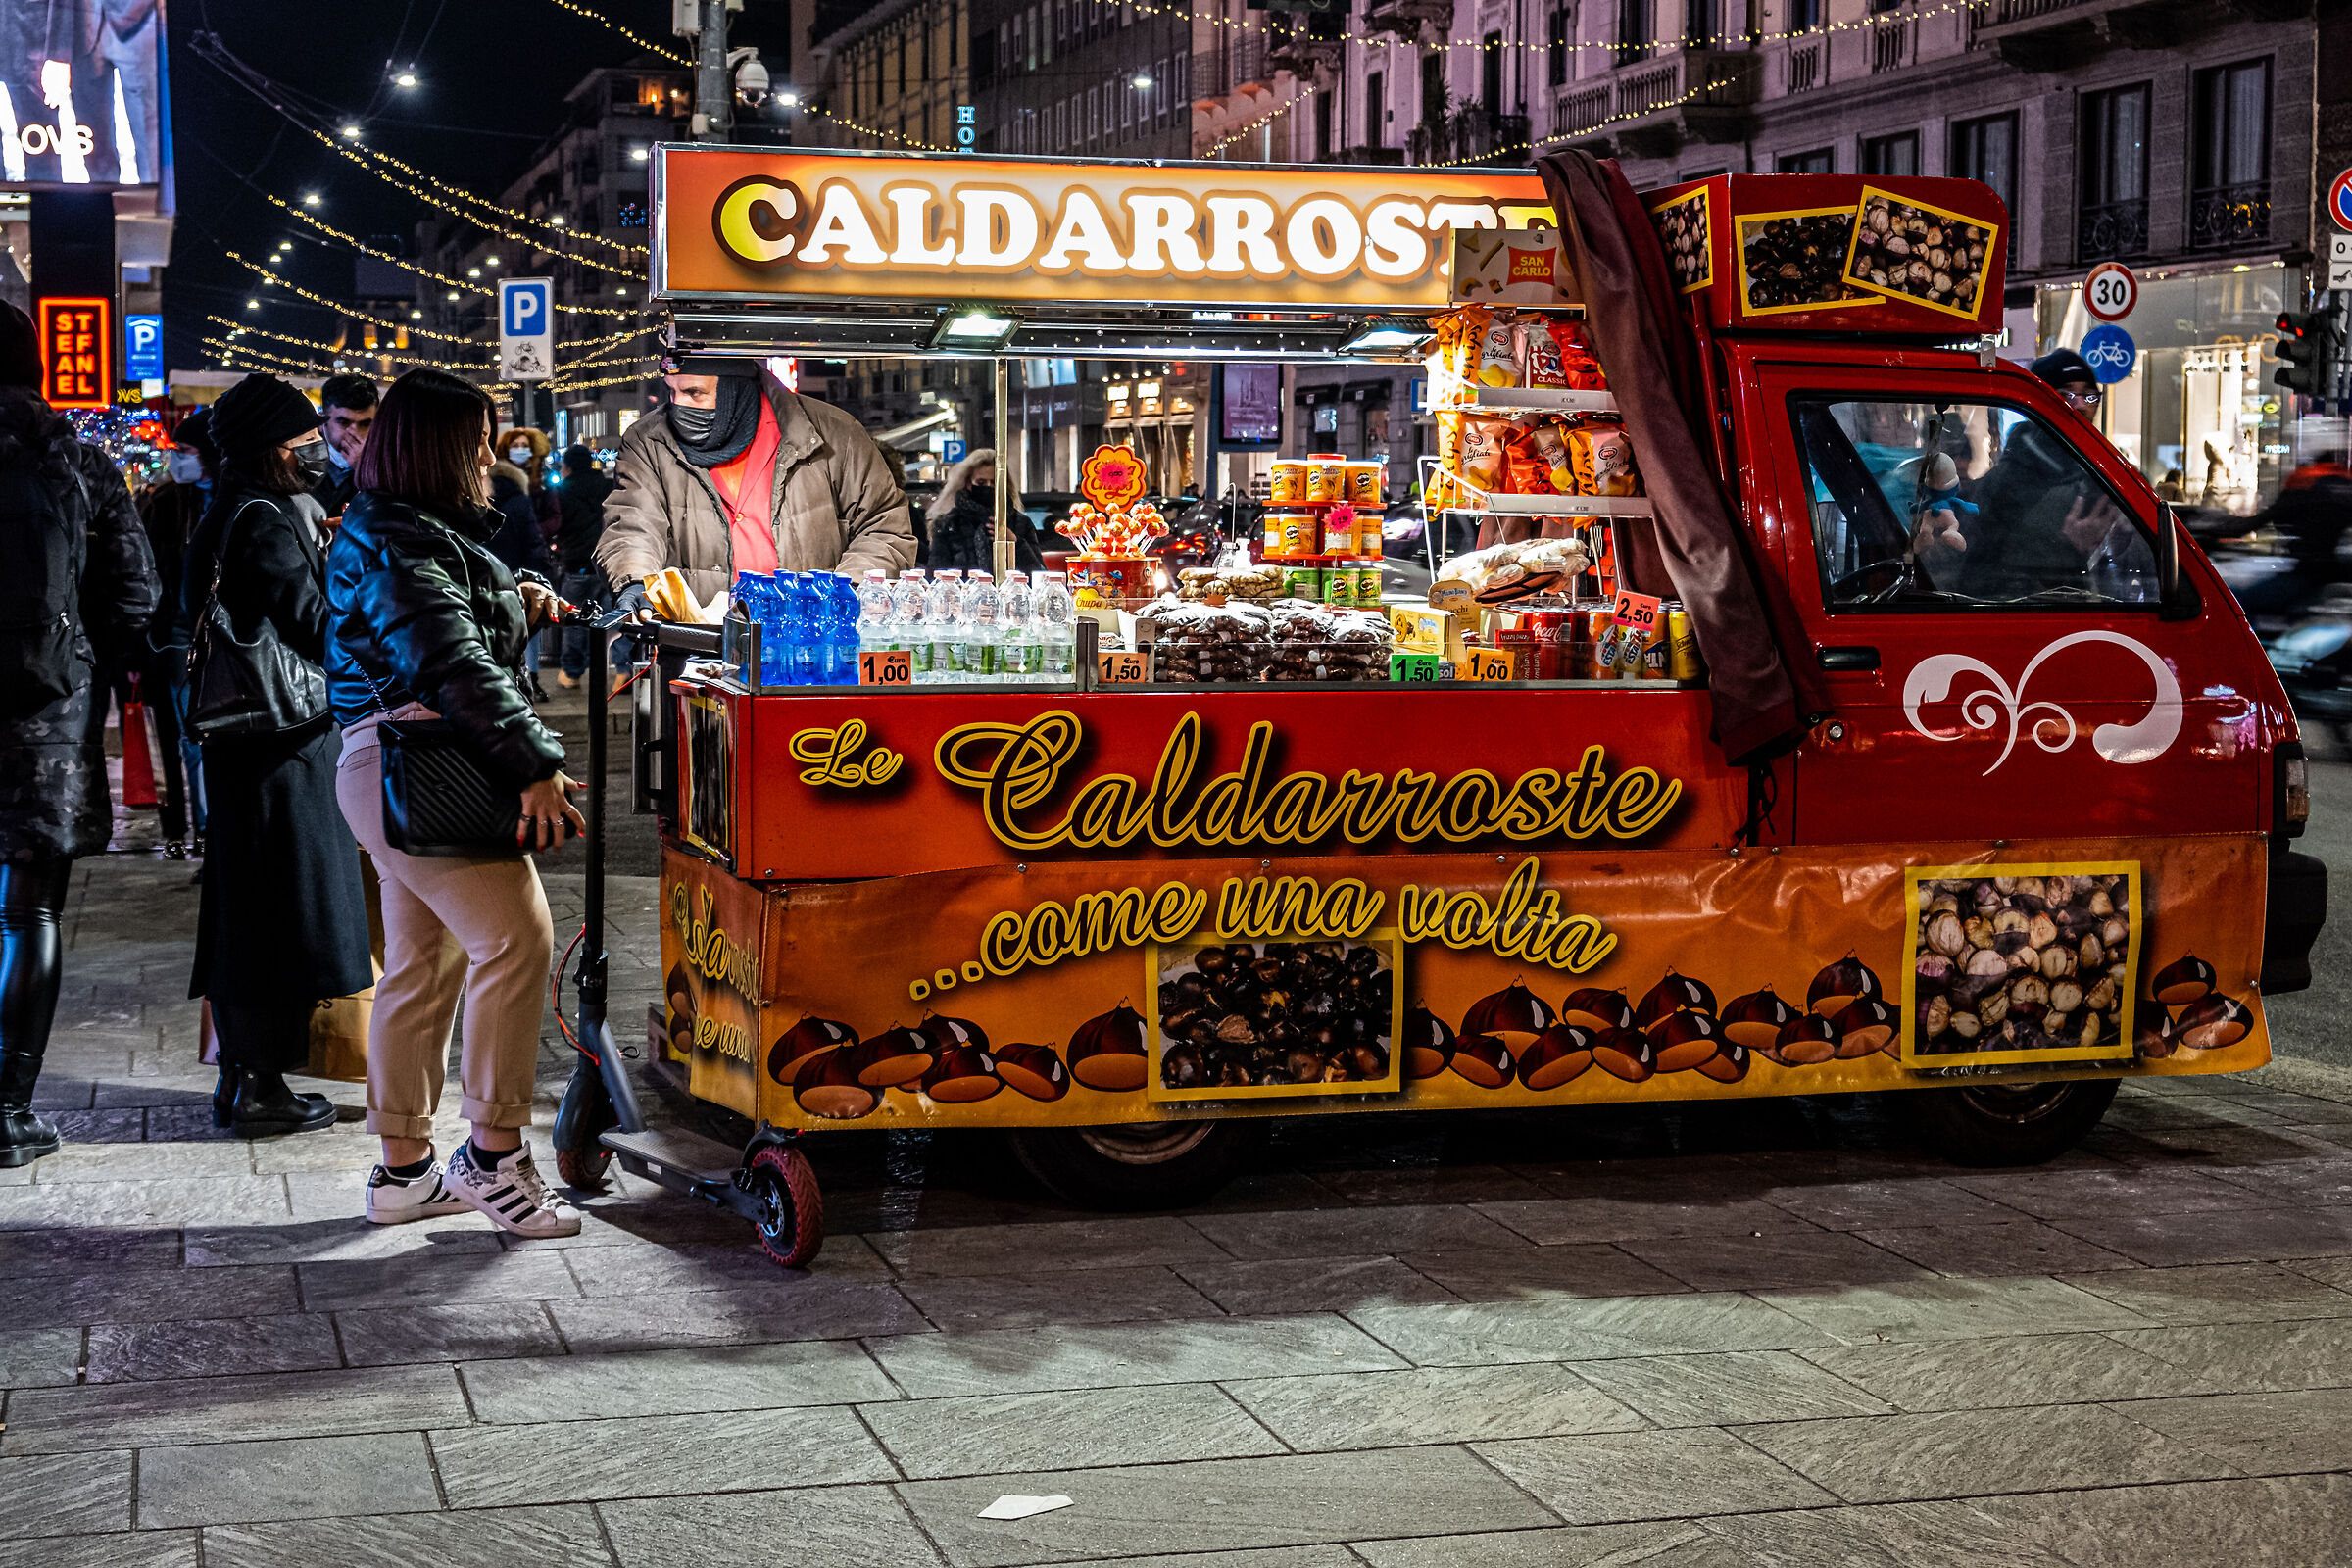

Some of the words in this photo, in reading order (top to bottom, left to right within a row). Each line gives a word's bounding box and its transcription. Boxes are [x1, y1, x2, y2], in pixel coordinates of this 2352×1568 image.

[957, 105, 976, 154] HO
[1512, 266, 1551, 276] CARLO
[1520, 256, 1545, 267] SAN
[2097, 278, 2127, 306] 30
[514, 291, 538, 330] P
[1617, 598, 1654, 624] 2,50
[863, 656, 909, 686] 1,00
[1102, 657, 1141, 683] 1,50
[1470, 653, 1508, 681] 1,00
[789, 718, 904, 788] Le
[934, 710, 1682, 850] Caldarroste
[1215, 876, 1385, 938] una
[1398, 856, 1618, 974] volta
